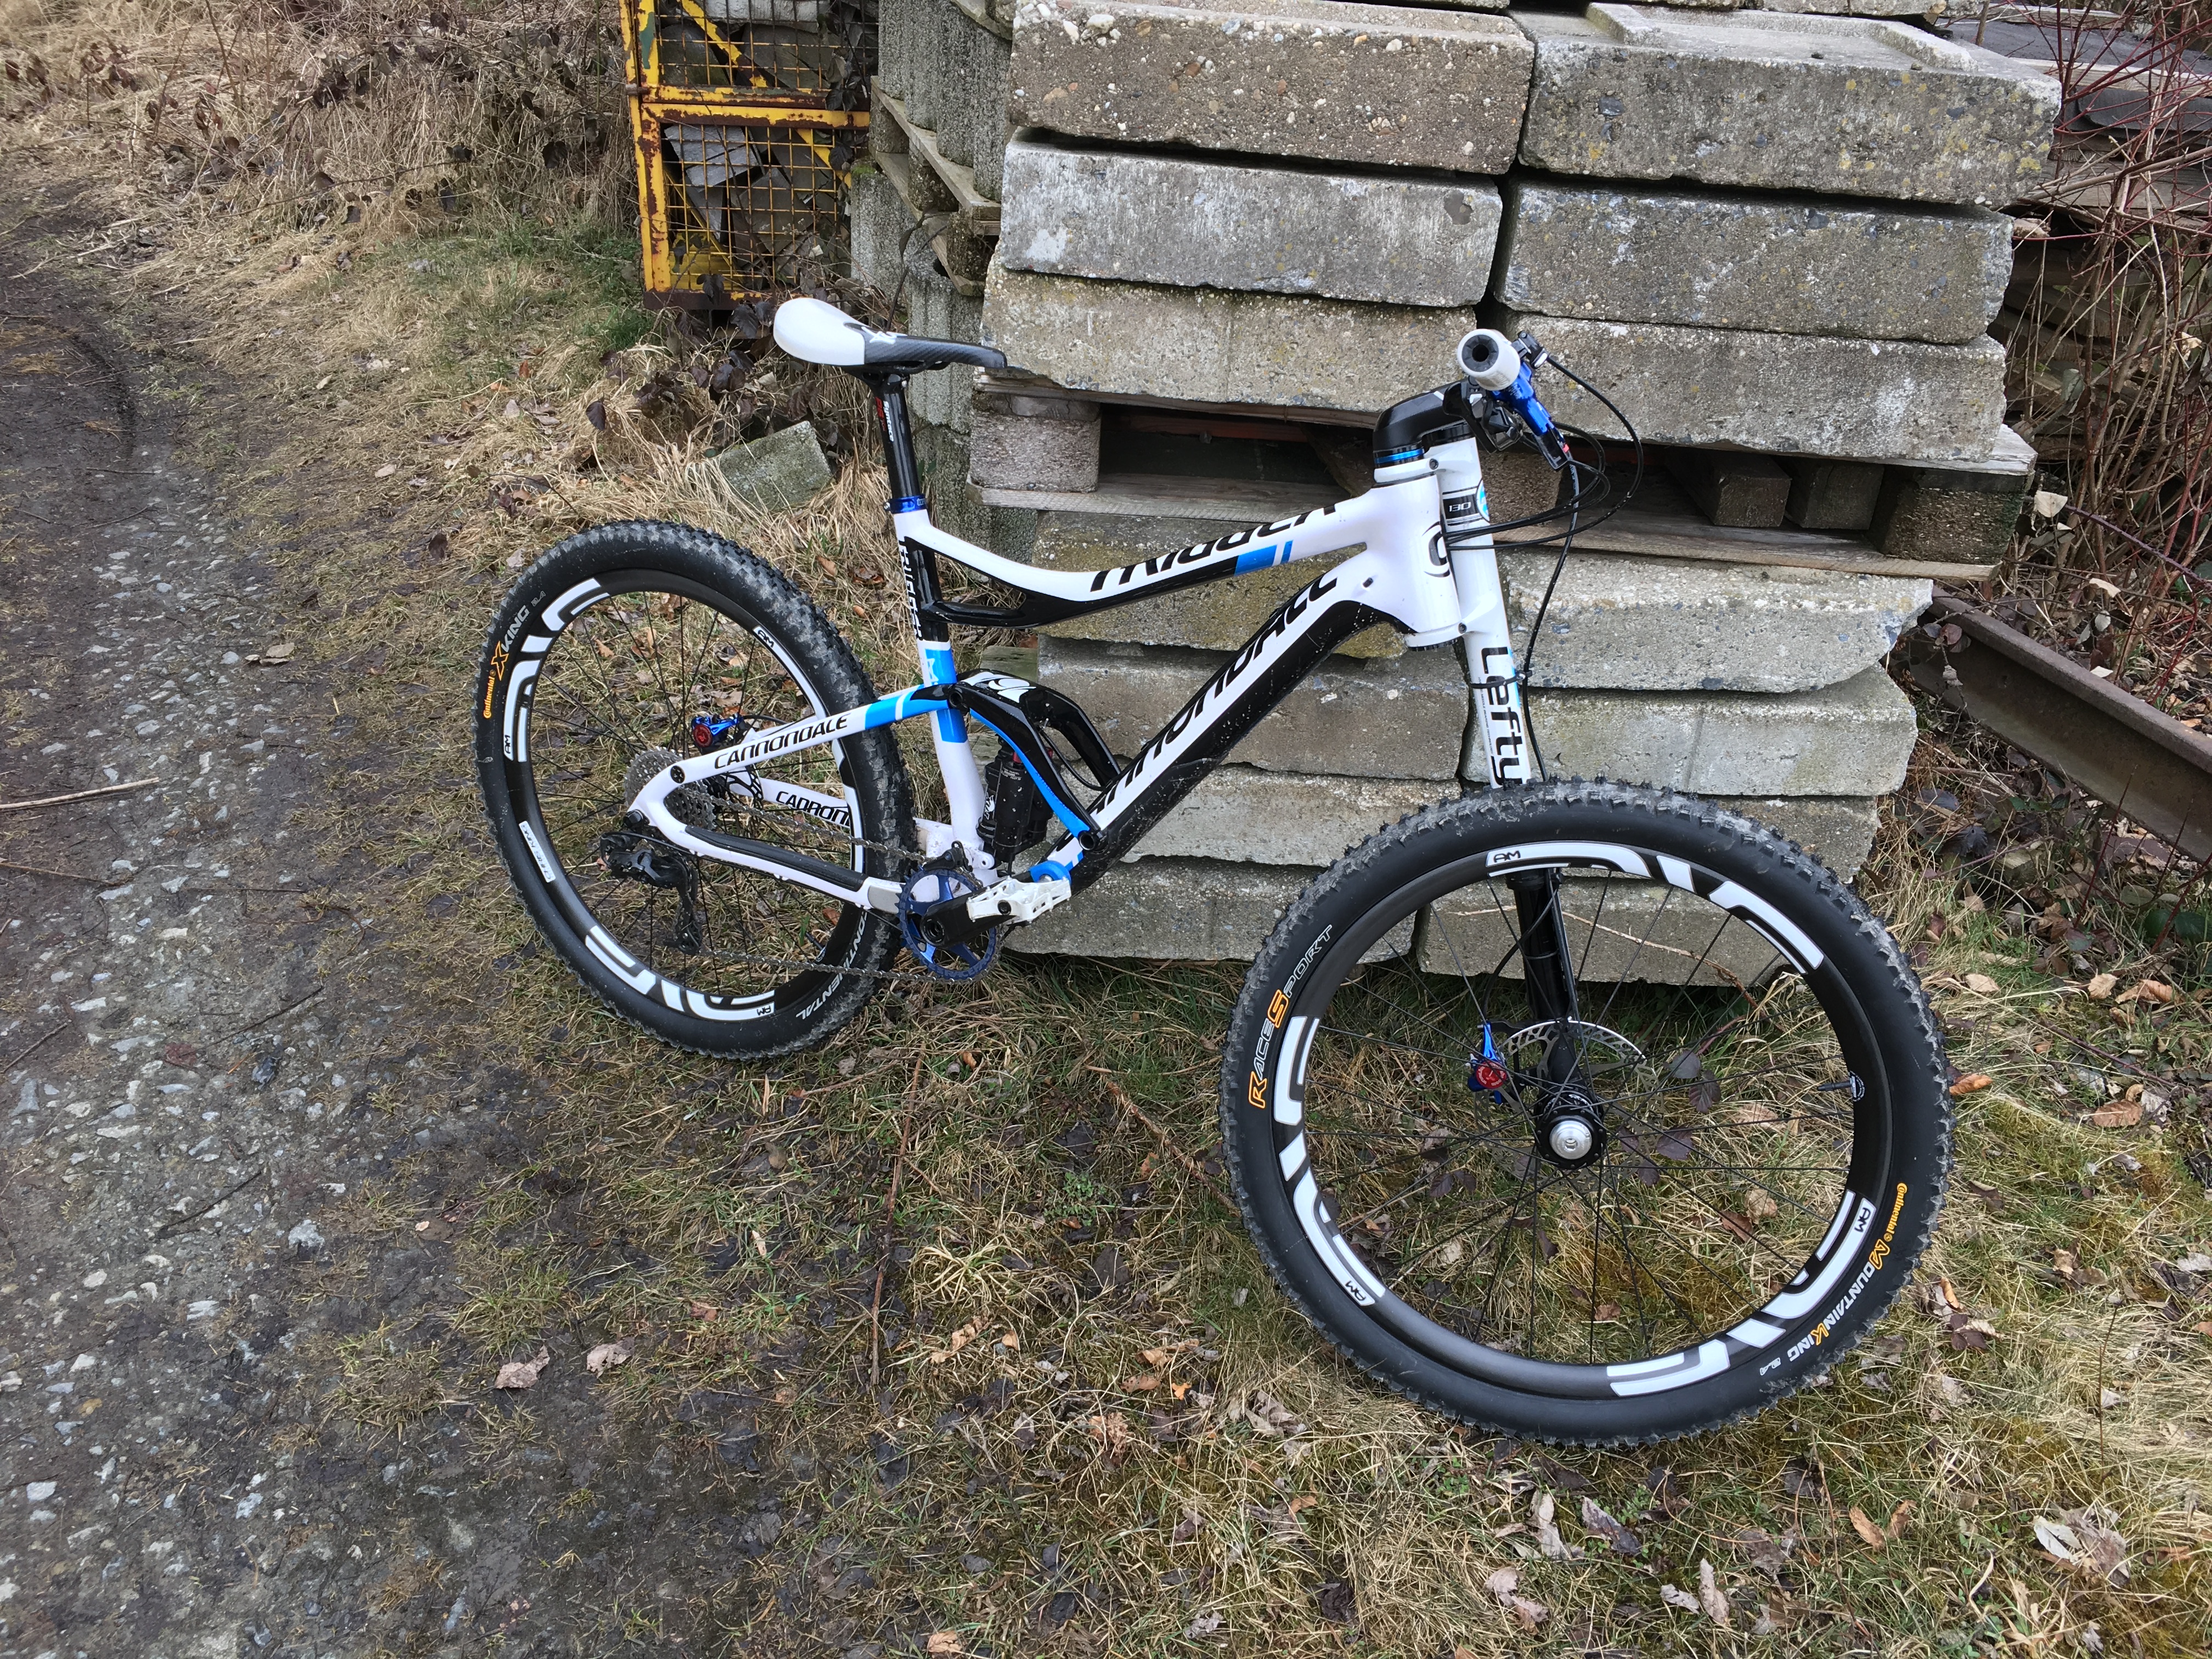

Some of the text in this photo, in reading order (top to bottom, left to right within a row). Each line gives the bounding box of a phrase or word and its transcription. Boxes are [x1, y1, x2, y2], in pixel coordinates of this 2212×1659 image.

[1449, 501, 1471, 512] 130
[483, 676, 496, 719] Continental
[714, 713, 851, 770] CANNONDALE
[776, 791, 850, 827] CANNON
[1493, 850, 1521, 863] AM
[1854, 1207, 1871, 1233] AM
[1888, 1182, 1908, 1235] Continental
[1345, 1280, 1367, 1301] AM
